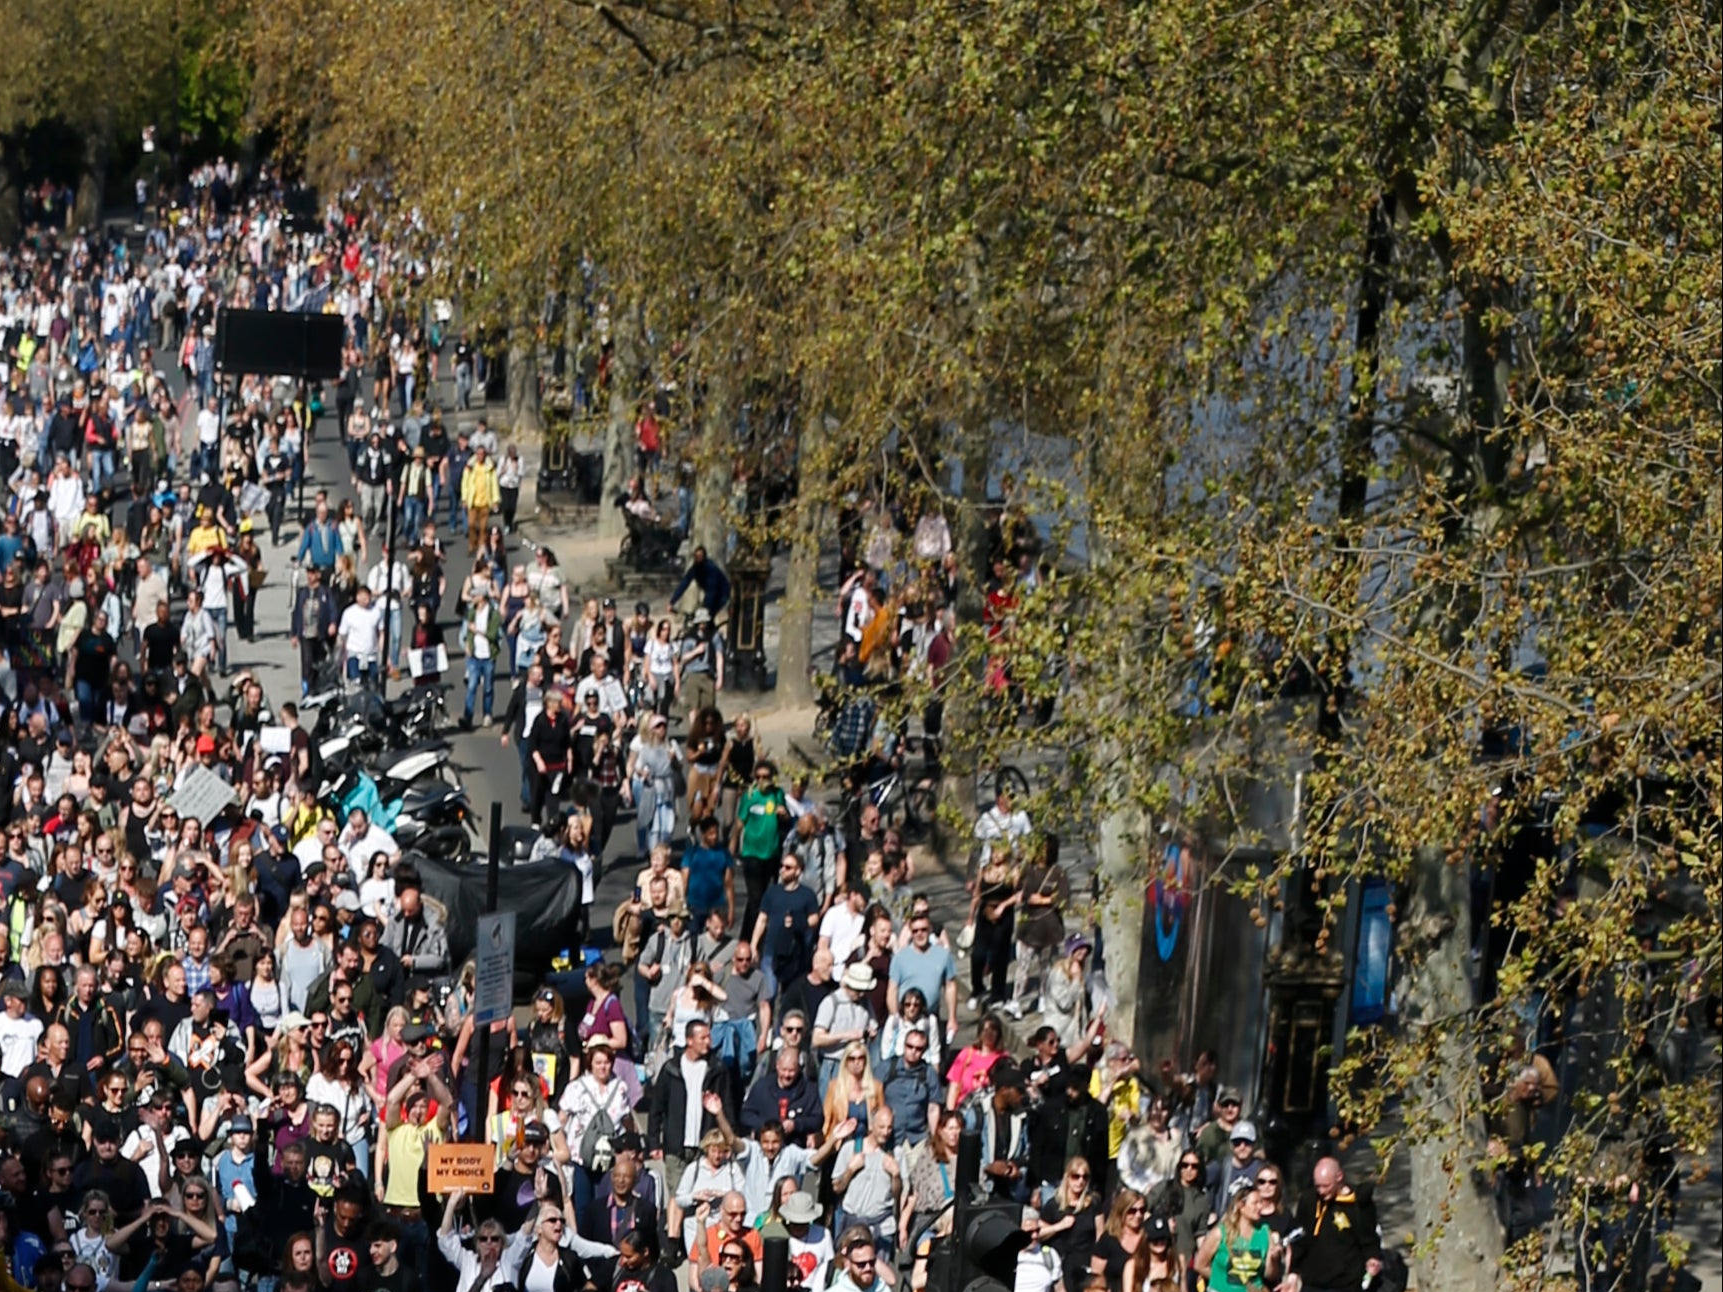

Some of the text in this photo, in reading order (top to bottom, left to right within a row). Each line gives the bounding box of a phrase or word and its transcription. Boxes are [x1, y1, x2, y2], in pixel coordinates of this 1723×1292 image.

[440, 1157, 481, 1165] MY BODY
[436, 1168, 485, 1177] MY CHOICE
